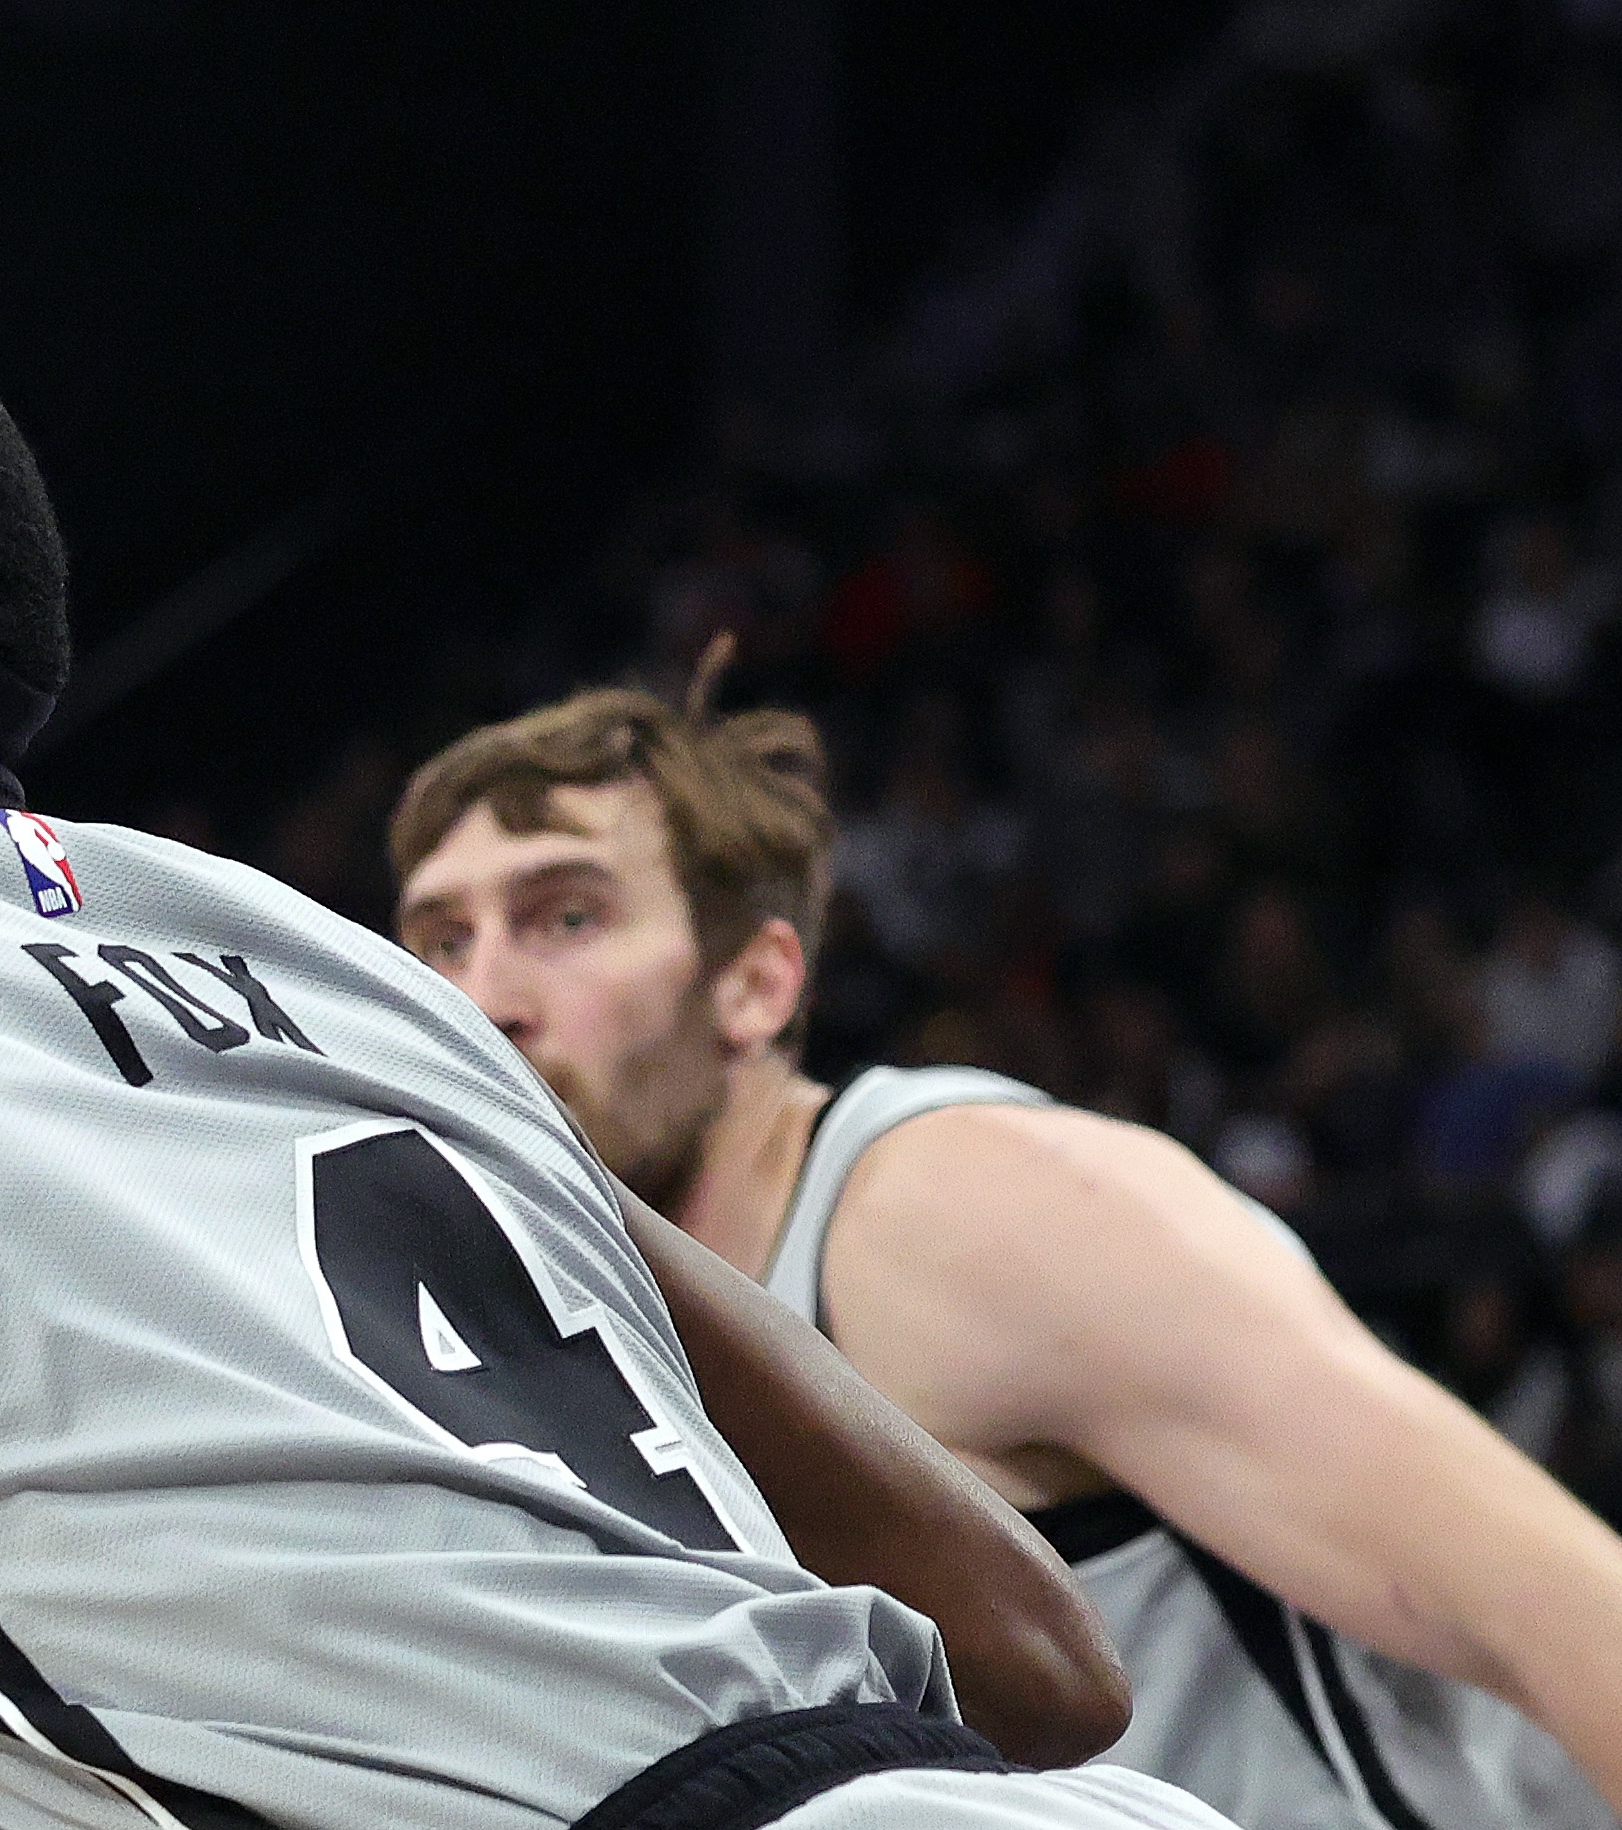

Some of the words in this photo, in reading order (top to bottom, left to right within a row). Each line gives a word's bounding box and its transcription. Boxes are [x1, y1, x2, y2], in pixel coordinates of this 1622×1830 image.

[38, 886, 68, 913] NBA
[21, 942, 326, 1088] FOX
[295, 1117, 755, 1556] 4
